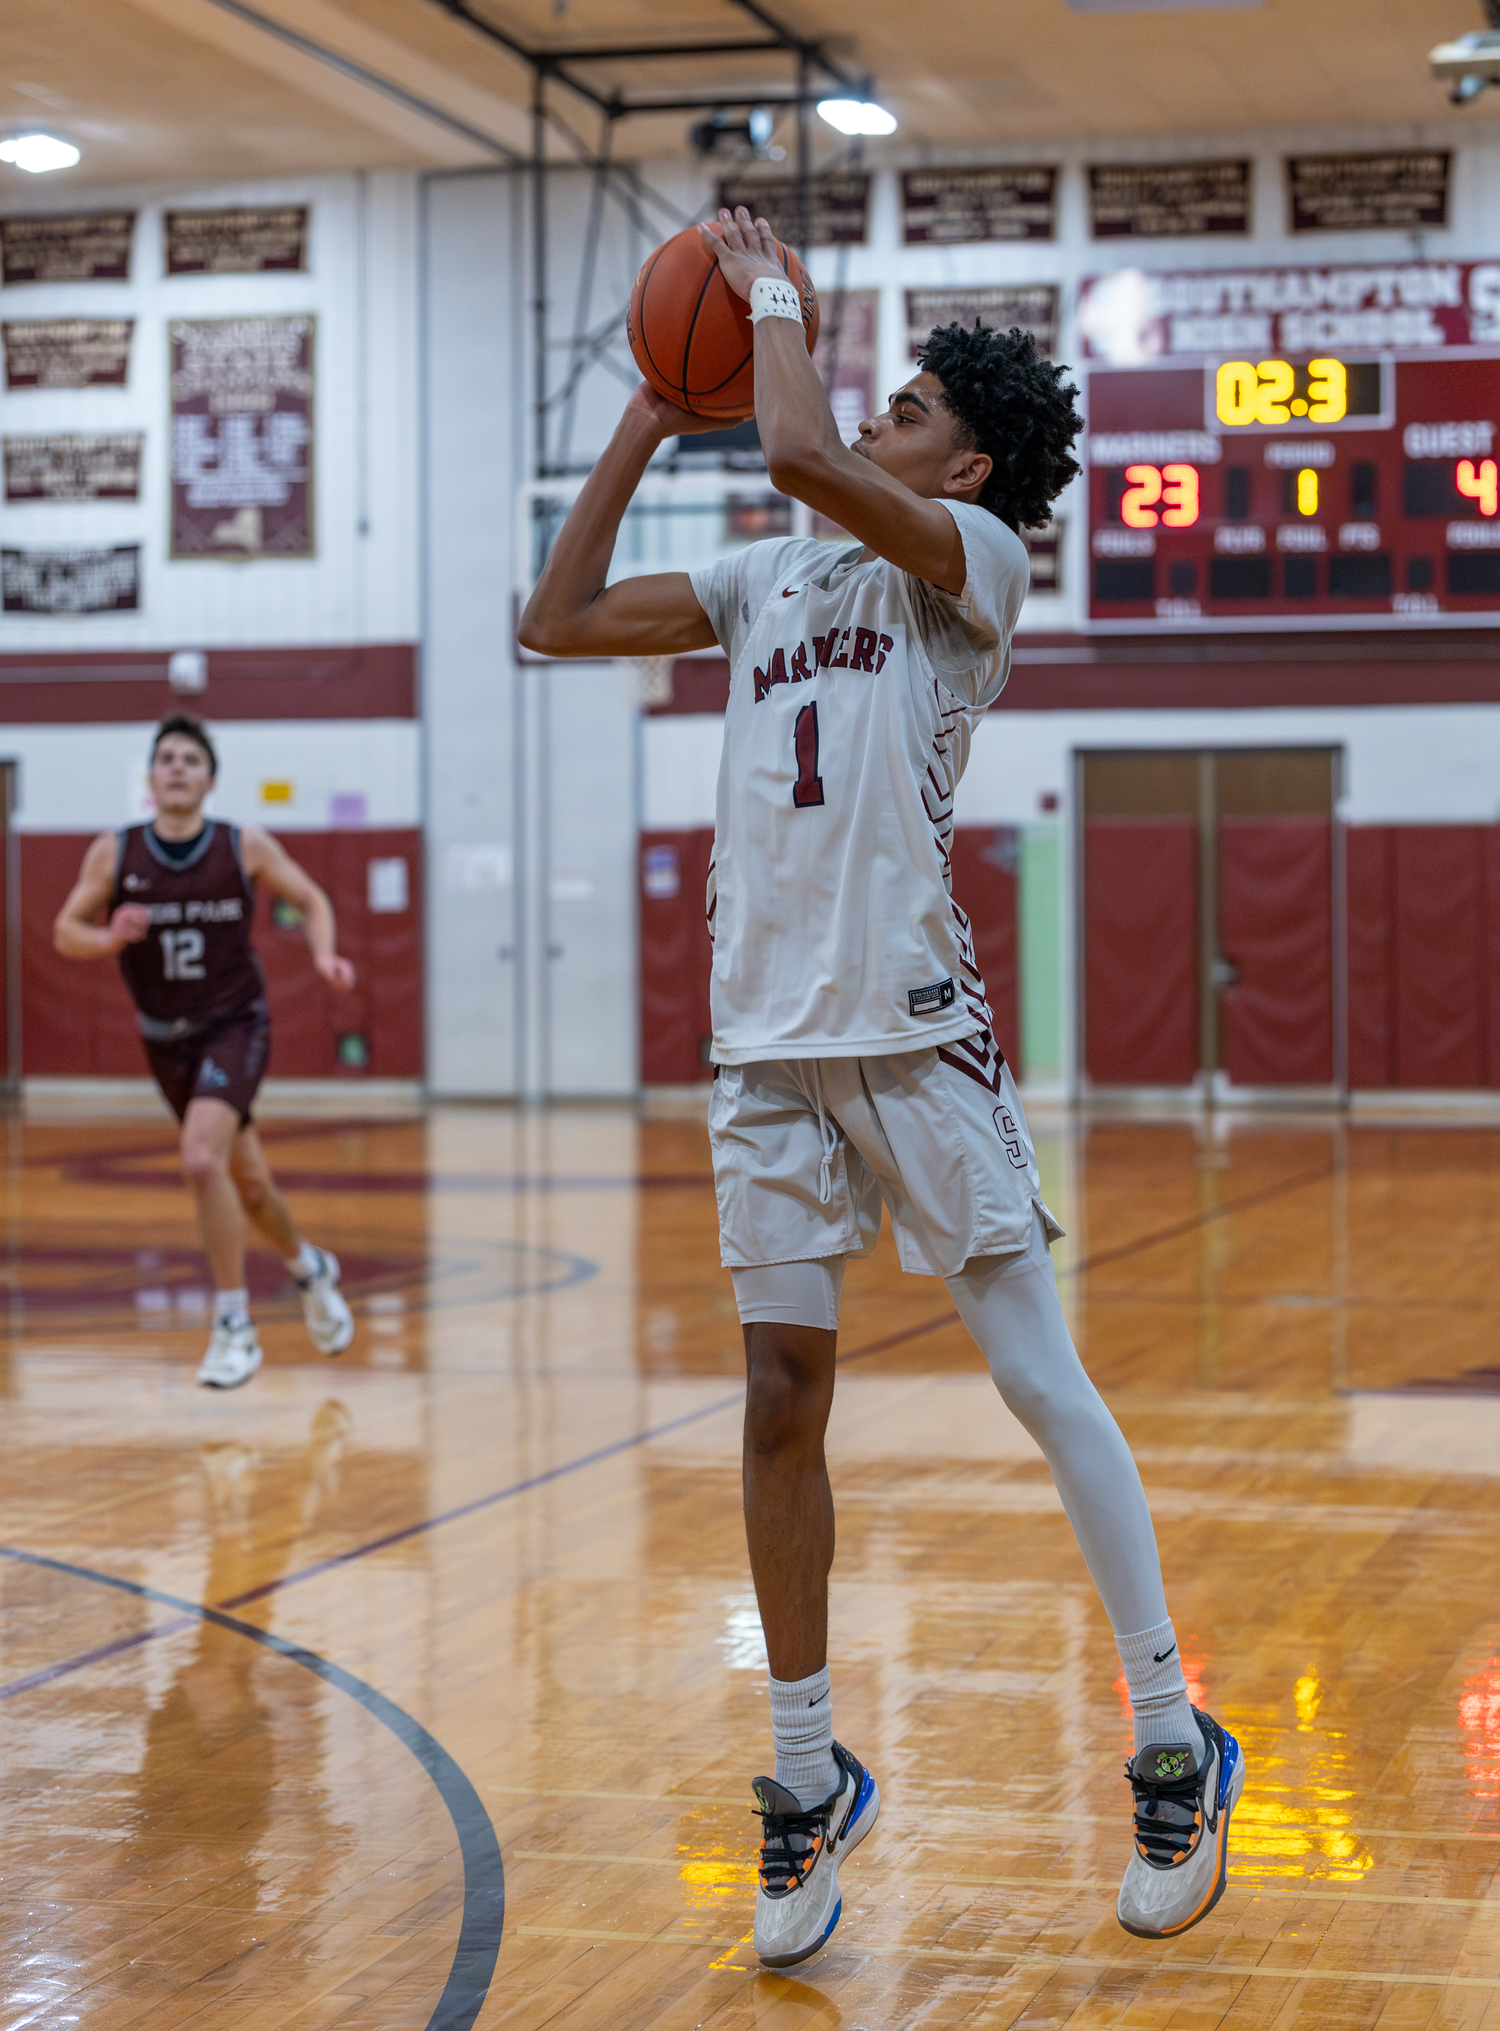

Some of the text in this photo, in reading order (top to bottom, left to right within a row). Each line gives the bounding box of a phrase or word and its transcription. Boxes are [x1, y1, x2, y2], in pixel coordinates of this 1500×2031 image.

[1216, 358, 1347, 426] 02.3
[1403, 420, 1496, 458] GUEST
[1121, 463, 1199, 528] 23
[1298, 468, 1318, 516] 1
[1456, 459, 1498, 516] 4
[793, 700, 825, 808] 1
[160, 928, 206, 980] 12
[993, 1105, 1028, 1169] S
